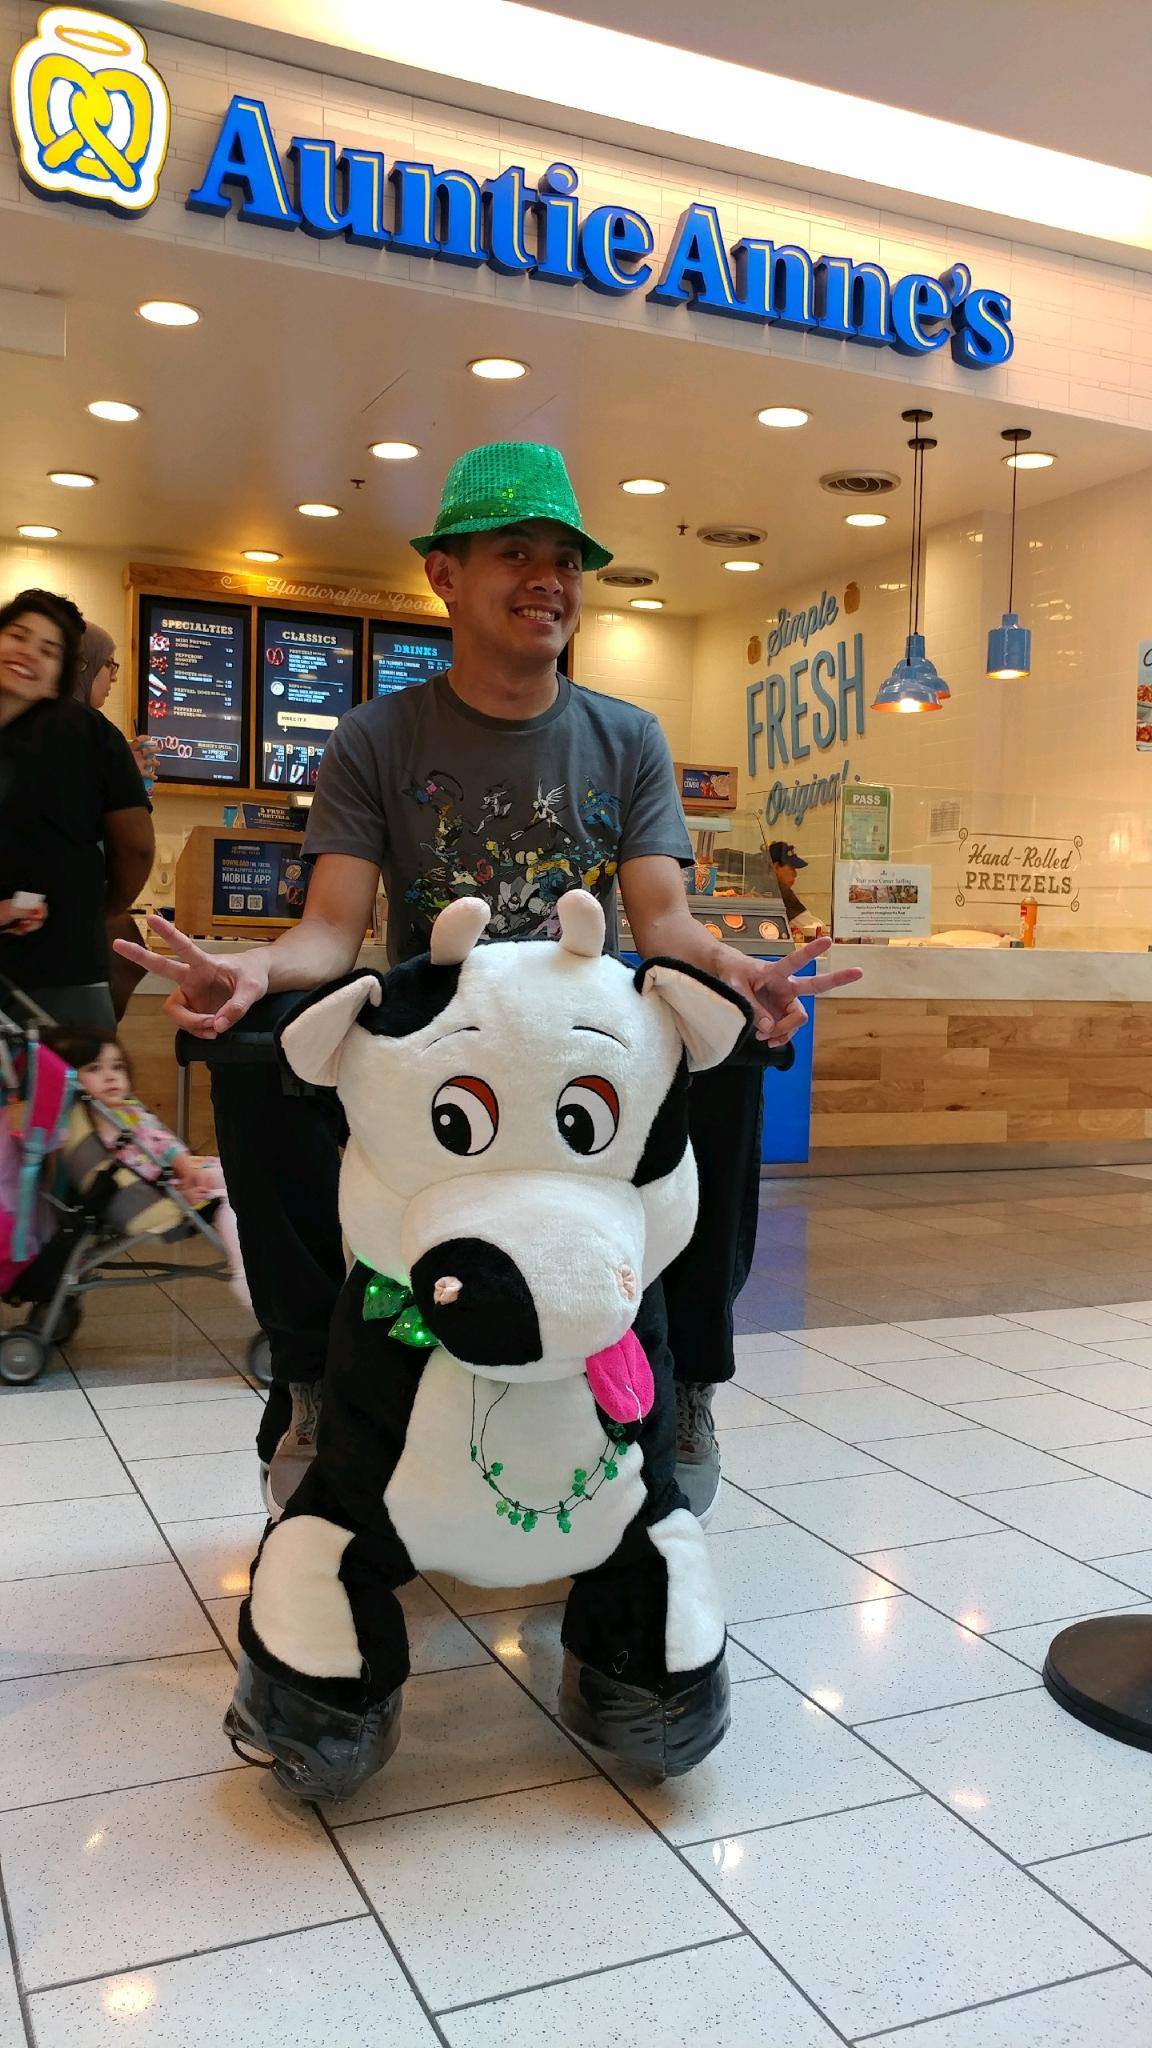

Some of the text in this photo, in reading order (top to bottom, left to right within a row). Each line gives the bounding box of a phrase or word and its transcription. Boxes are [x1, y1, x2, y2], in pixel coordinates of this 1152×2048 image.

[186, 94, 1014, 370] Auntie Anne's
[266, 577, 381, 606] Handcrafted
[161, 618, 234, 635] SPECIALTIES
[282, 631, 337, 645] CLASSICS
[767, 590, 839, 666] Simple
[393, 643, 438, 657] DRINKS
[746, 632, 864, 777] FRESH
[765, 759, 850, 826] Original
[852, 794, 881, 805] PASS
[222, 859, 250, 867] DOWNLOAD
[967, 843, 1074, 870] Hand-Rolled
[222, 873, 271, 885] MOBILE APP
[964, 871, 1073, 895] PRETZELS
